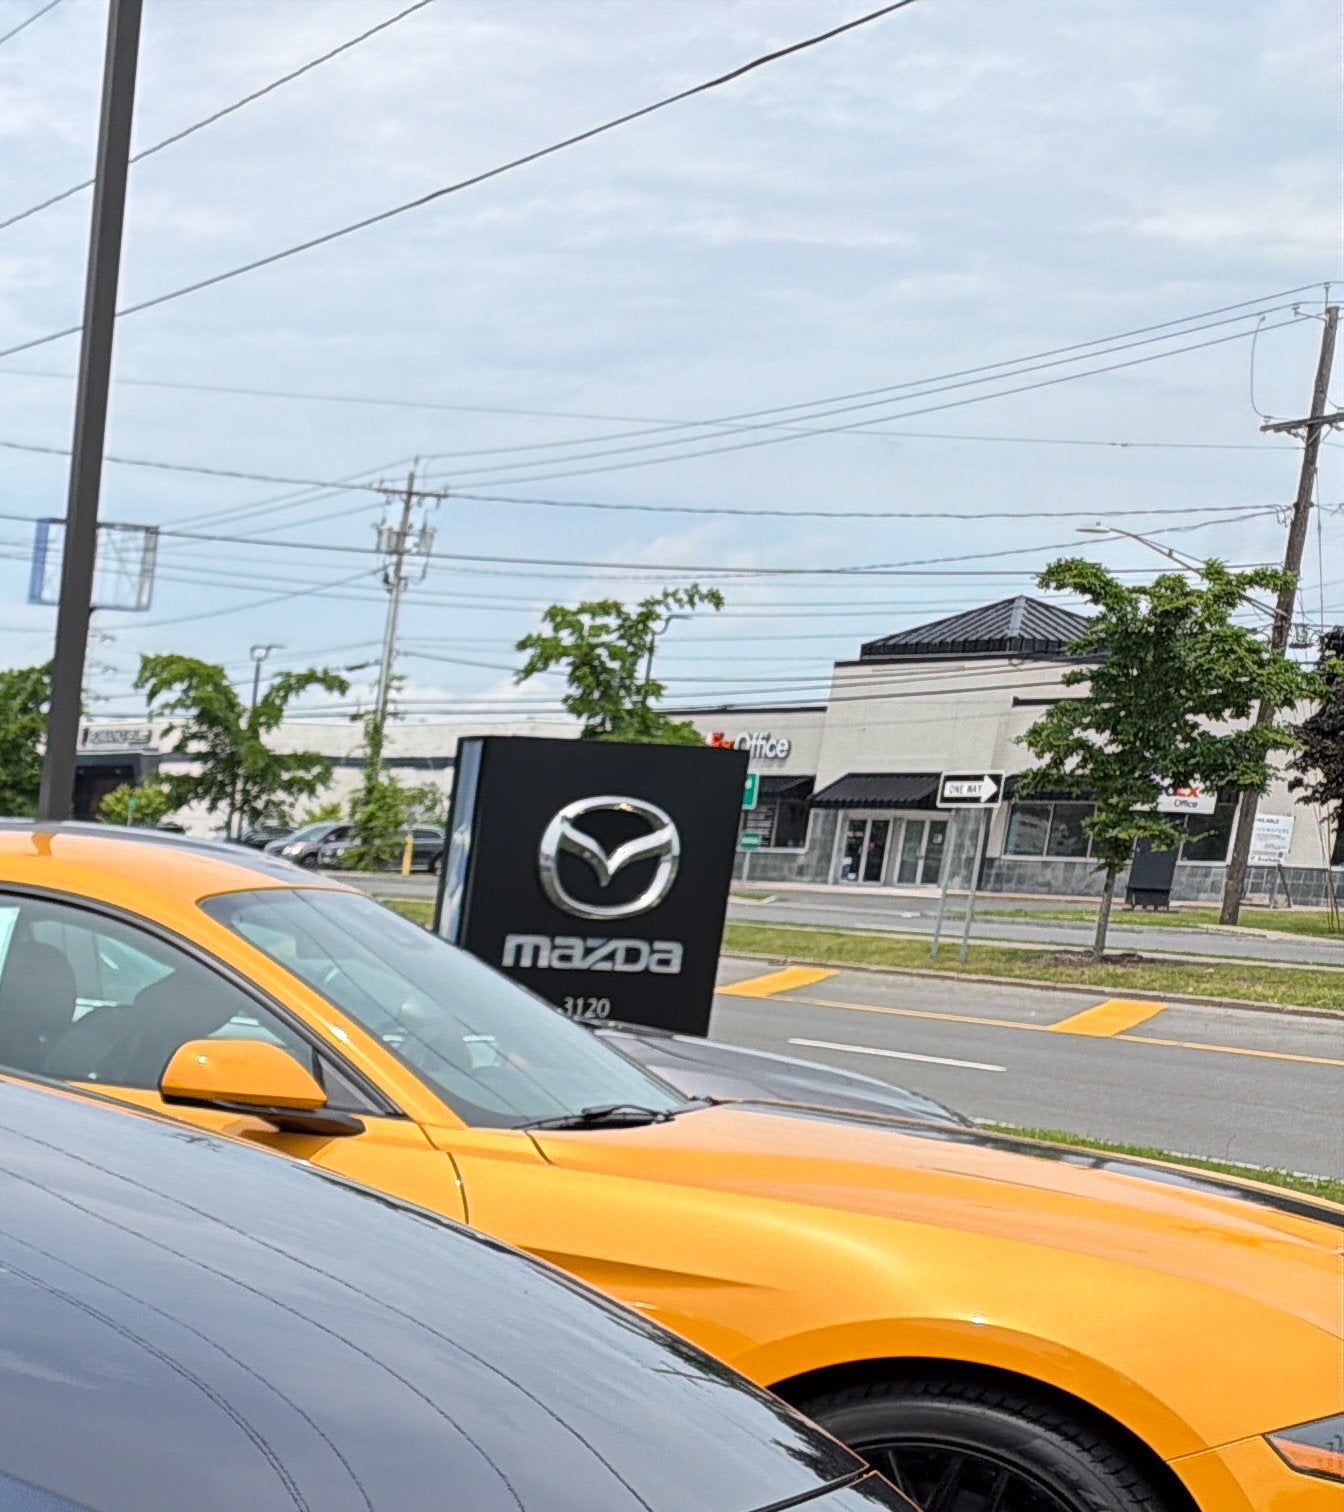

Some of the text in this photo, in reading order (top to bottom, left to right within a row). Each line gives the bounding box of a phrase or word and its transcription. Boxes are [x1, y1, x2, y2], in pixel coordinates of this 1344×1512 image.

[734, 732, 789, 758] Office
[948, 784, 983, 795] ONE WAY
[1174, 799, 1199, 808] Office
[563, 996, 611, 1020] 3120
